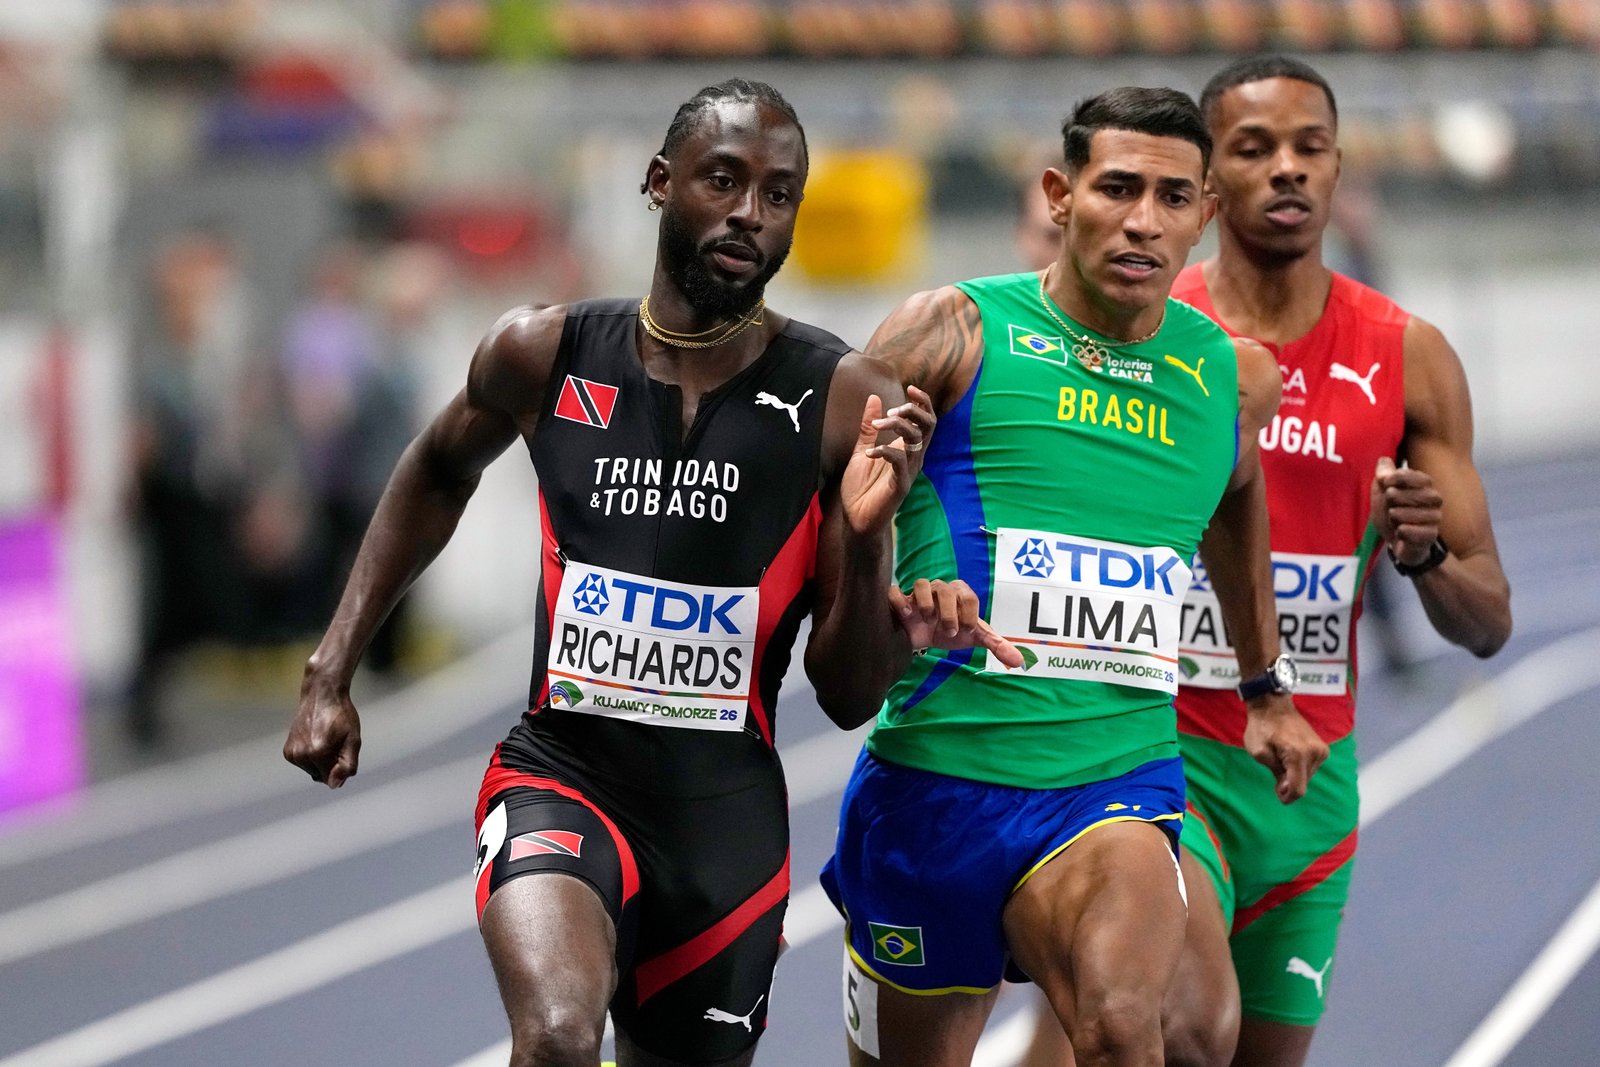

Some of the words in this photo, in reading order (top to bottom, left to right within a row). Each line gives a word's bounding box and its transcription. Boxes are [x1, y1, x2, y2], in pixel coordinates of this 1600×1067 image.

[1107, 355, 1153, 371] loterias
[1108, 367, 1154, 384] CAIXA
[1057, 386, 1175, 446] BRASIL
[1258, 414, 1343, 464] UGAL
[594, 457, 740, 493] TRINIDAD
[1055, 541, 1181, 596] TDK
[1271, 560, 1345, 601] DK
[611, 577, 746, 635] TDK
[1028, 591, 1158, 648] LIMA
[1178, 603, 1340, 654] TARES
[556, 622, 743, 690] RICHARDS
[1047, 656, 1102, 671] KUJAWY
[1103, 661, 1163, 680] POMORZE
[1164, 670, 1174, 683] 26
[592, 694, 651, 713] KUJAWY
[651, 705, 718, 720] POMORZE
[719, 709, 738, 721] 26
[847, 970, 861, 1031] 5
